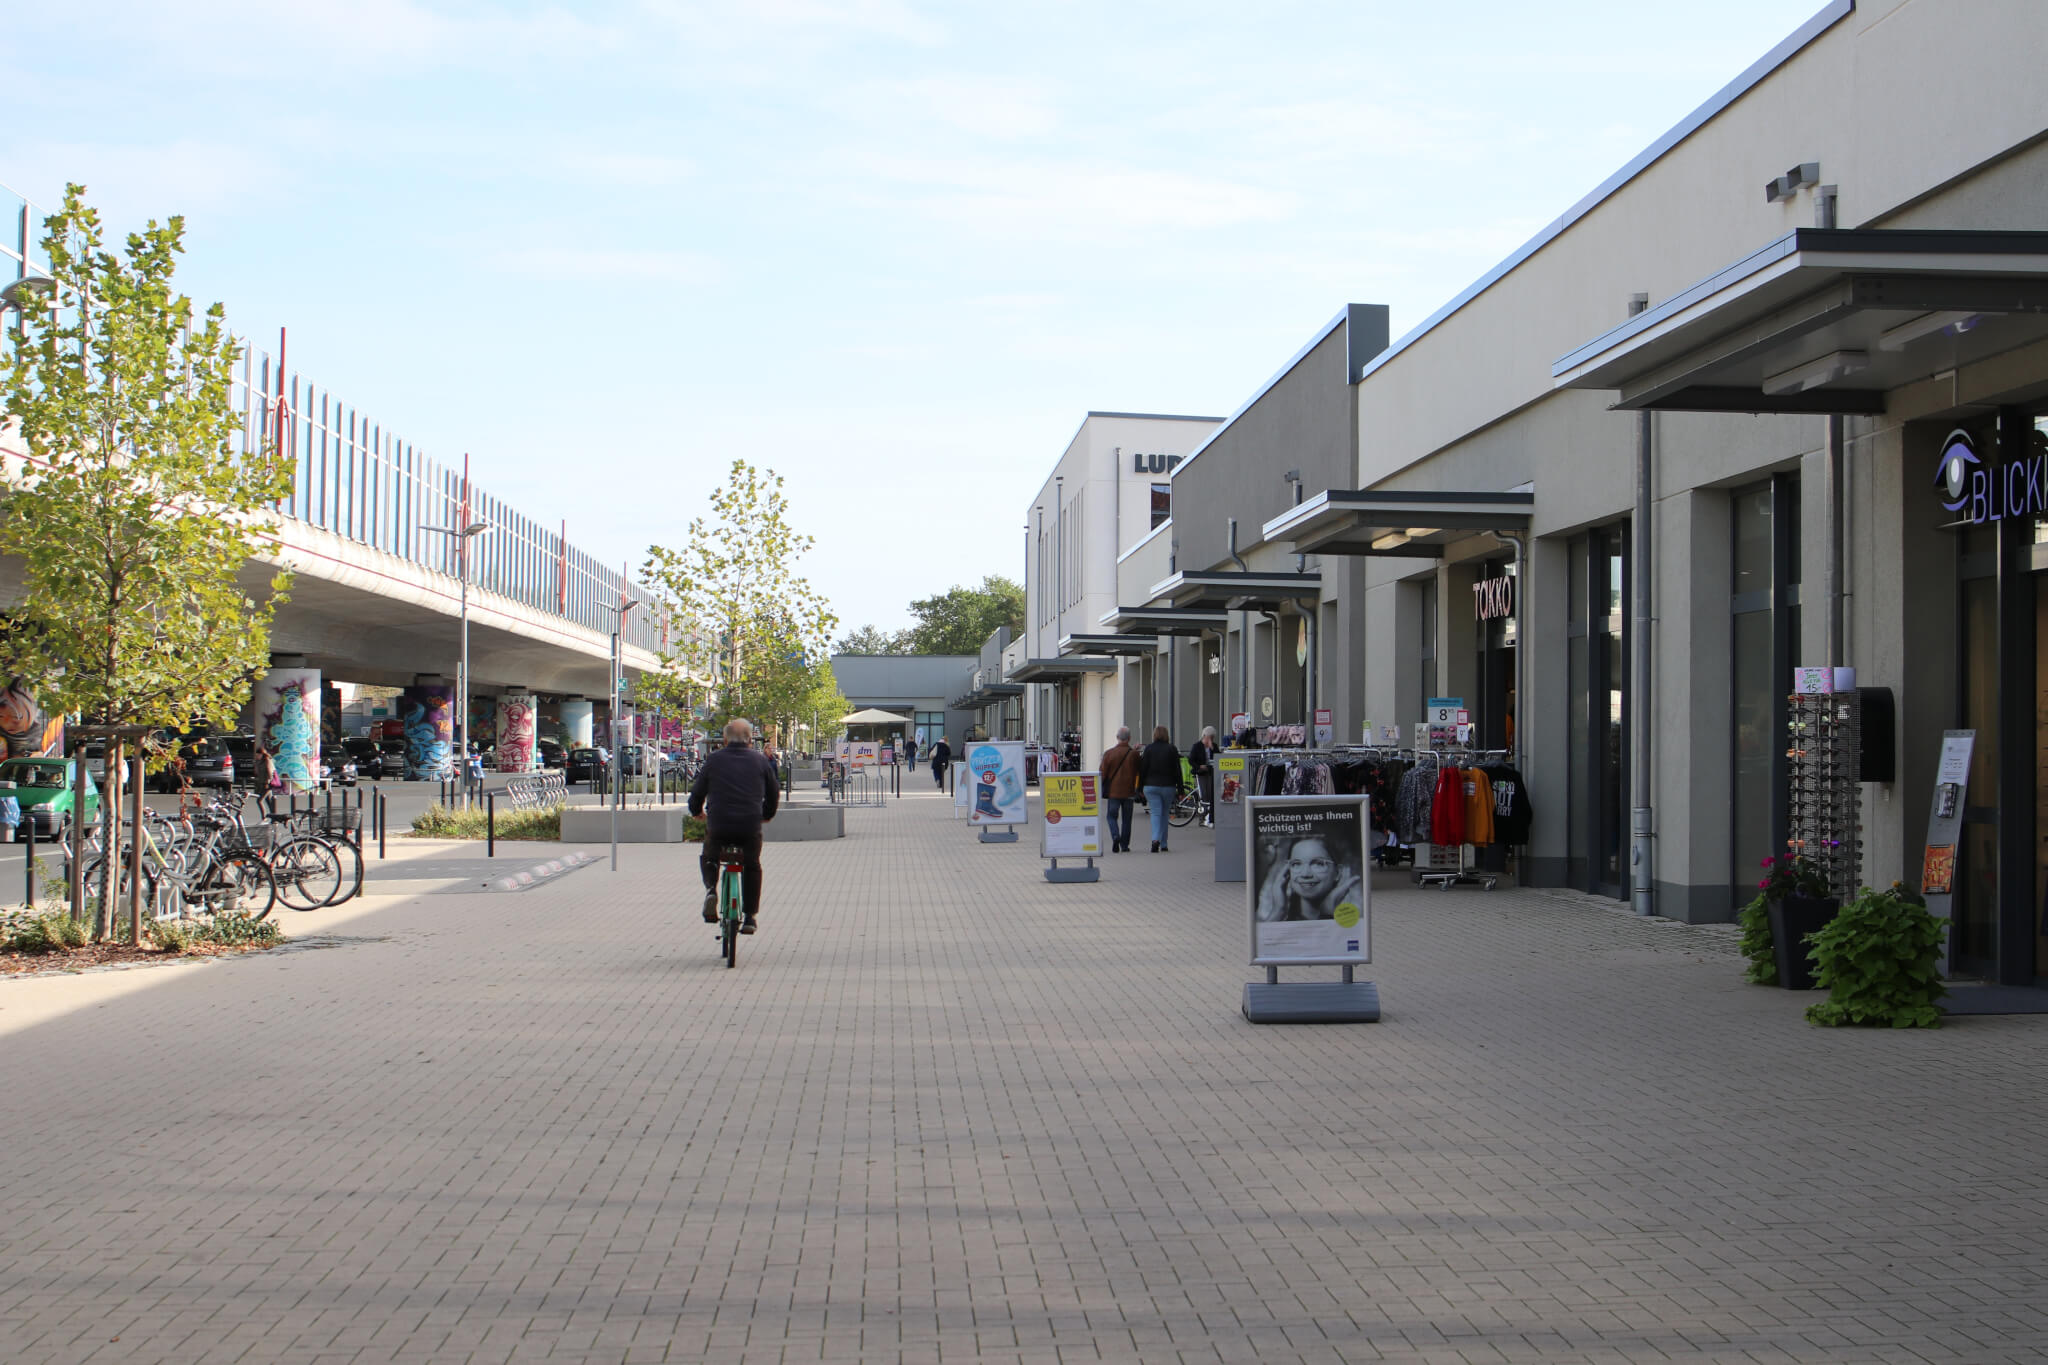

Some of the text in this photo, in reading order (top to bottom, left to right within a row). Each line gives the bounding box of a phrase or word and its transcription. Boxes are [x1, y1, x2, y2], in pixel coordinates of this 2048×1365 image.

[1973, 453, 2048, 524] BLICK
[1440, 709, 1448, 720] 8
[858, 746, 872, 755] dm
[1057, 779, 1077, 791] VIP
[1258, 813, 1302, 823] Schützen
[1326, 811, 1353, 820] Ihnen
[1258, 823, 1312, 834] wichtig ist!
